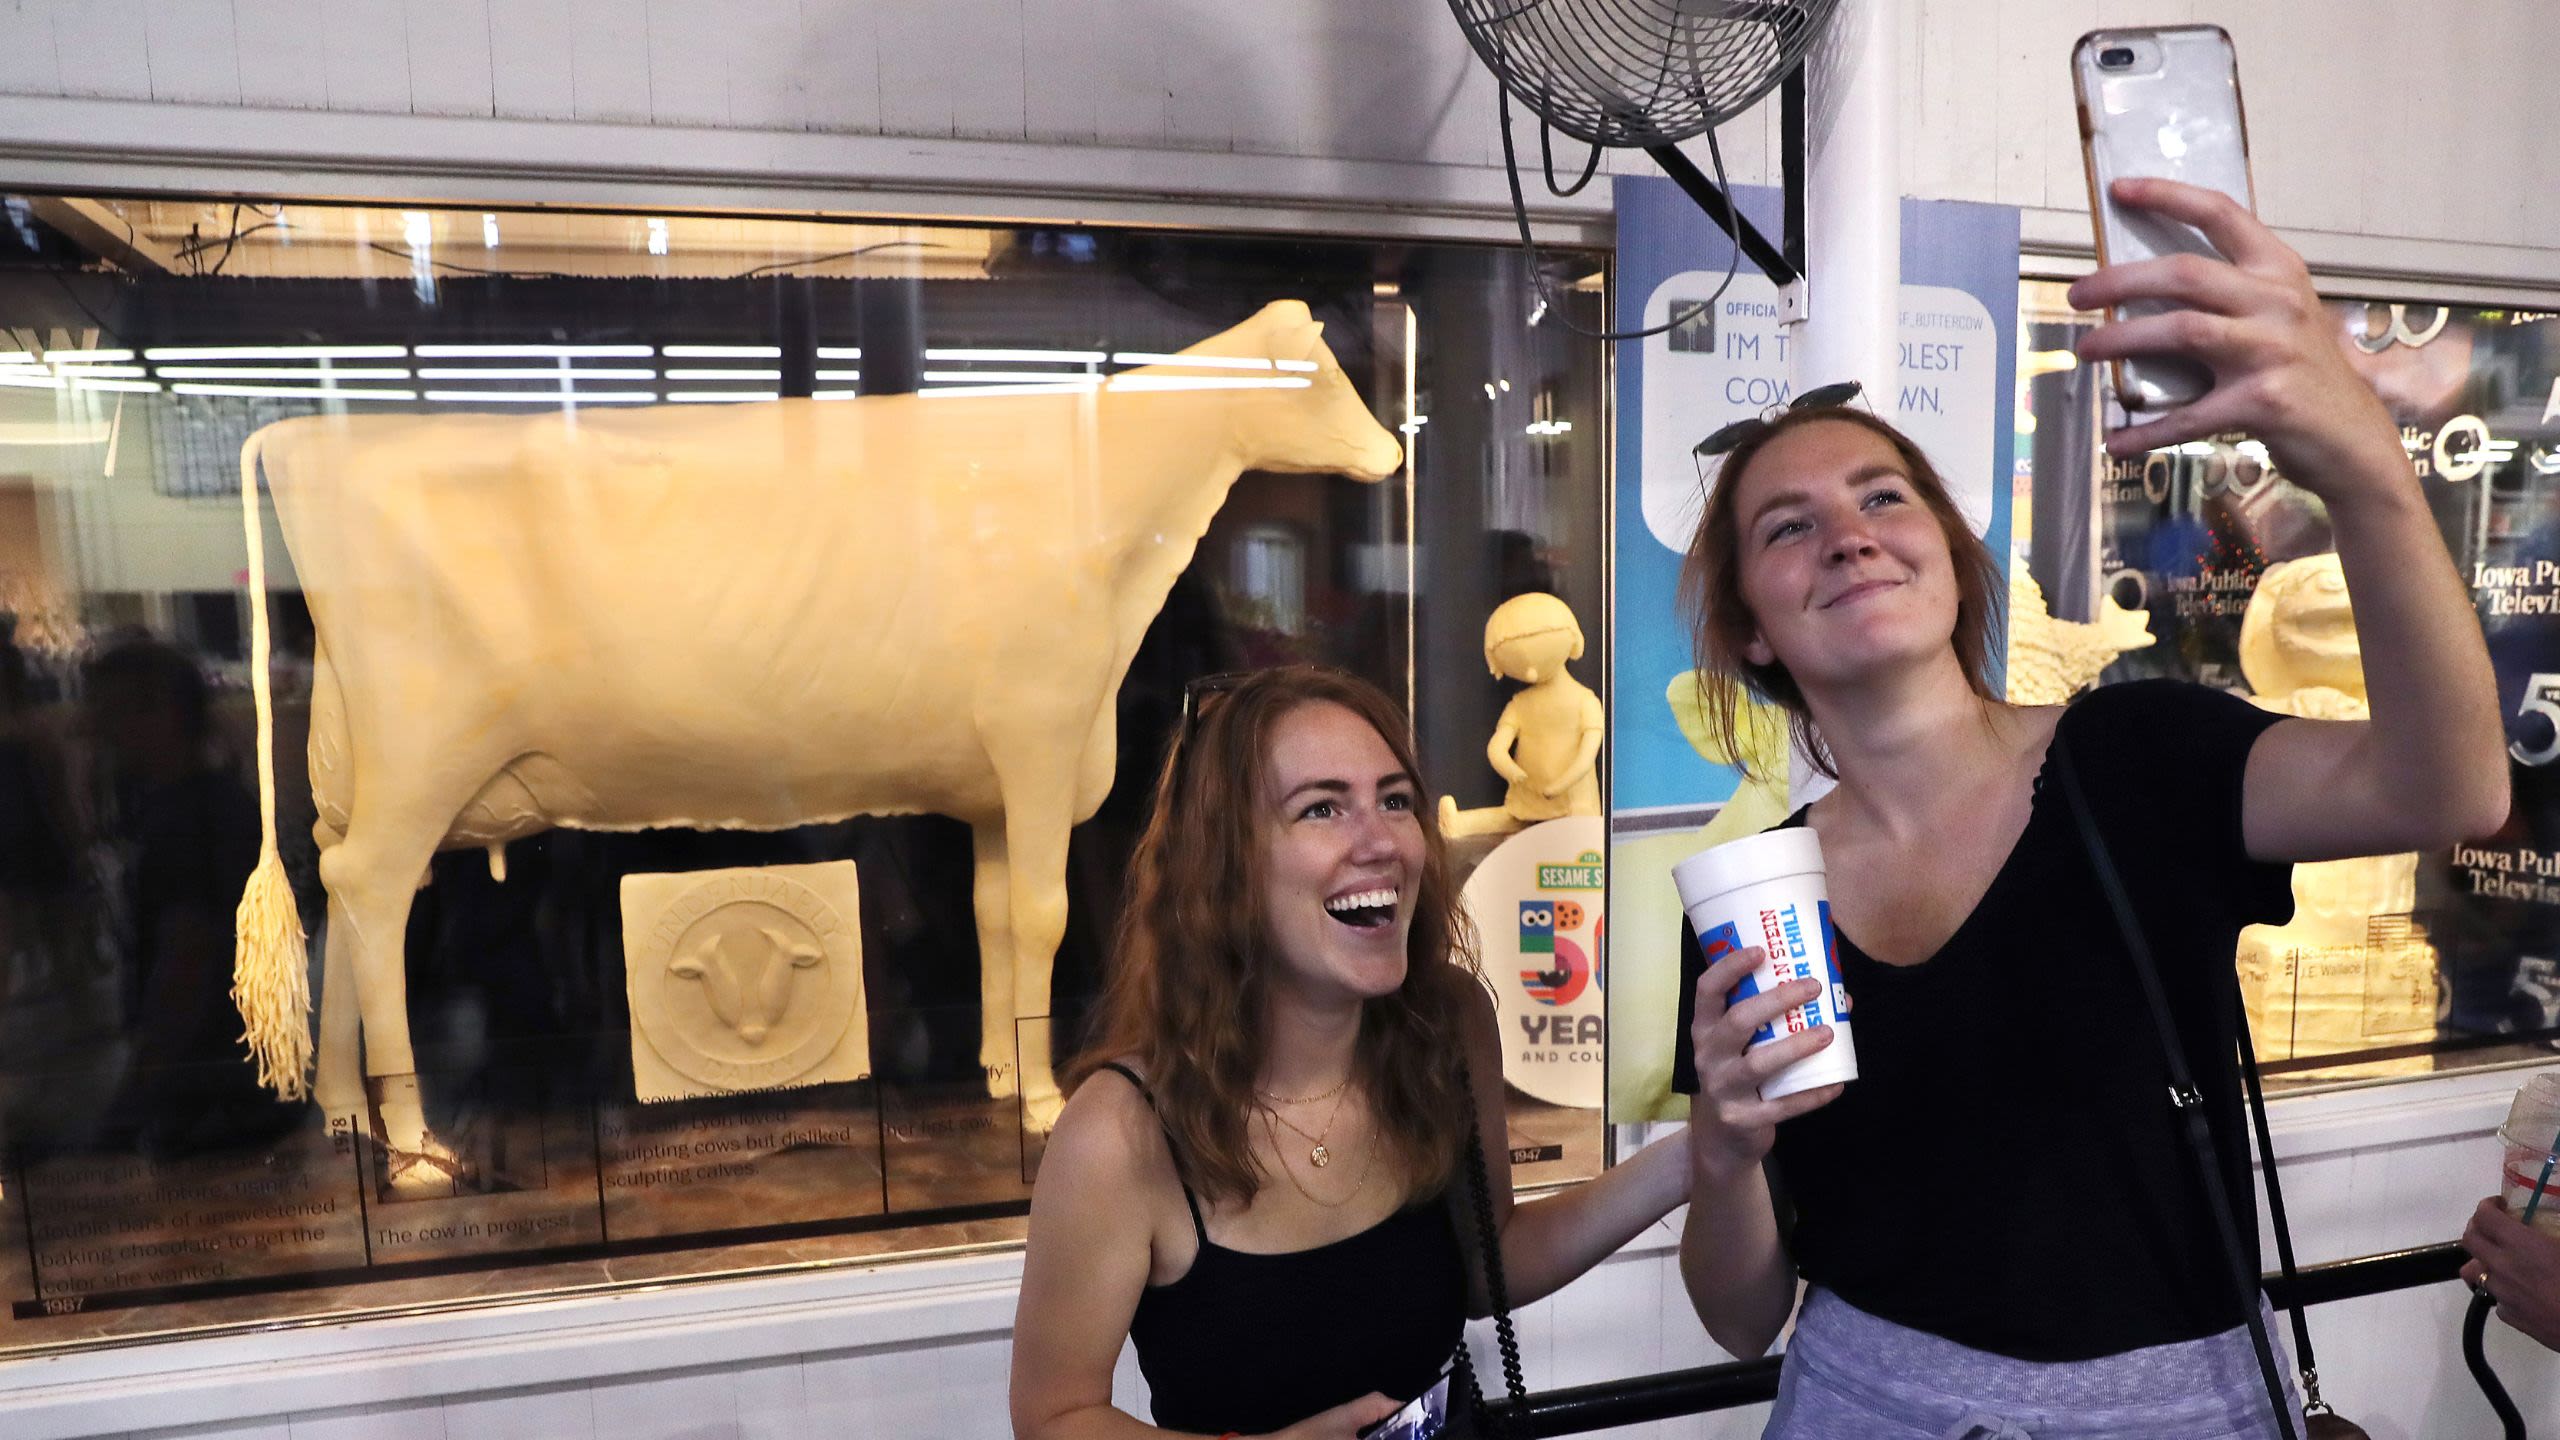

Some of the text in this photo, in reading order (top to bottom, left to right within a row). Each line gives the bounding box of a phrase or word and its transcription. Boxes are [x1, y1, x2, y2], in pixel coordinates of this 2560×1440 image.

[1727, 332, 1760, 360] I'M
[2472, 561, 2531, 589] Iowa
[2452, 843, 2513, 873] Iowa
[1541, 867, 1591, 887] SESAME
[1759, 908, 1787, 960] STEIN
[1780, 903, 1807, 958] CHILL
[1522, 1051, 1559, 1063] AND
[332, 1117, 350, 1155] 1978
[604, 1126, 852, 1165] sculpting cows but disliked
[1513, 1148, 1542, 1163] 1947
[605, 1160, 761, 1189] sculpting calves.
[36, 1216, 112, 1241] double
[171, 1210, 191, 1228] of
[198, 1198, 337, 1226] unsweetened
[377, 1228, 413, 1246] The
[419, 1223, 457, 1242] cow
[463, 1219, 481, 1237] in
[40, 1225, 326, 1269] baking chocolate to get the
[43, 1273, 98, 1295] color
[103, 1270, 143, 1290] she
[43, 1296, 85, 1315] 1987
